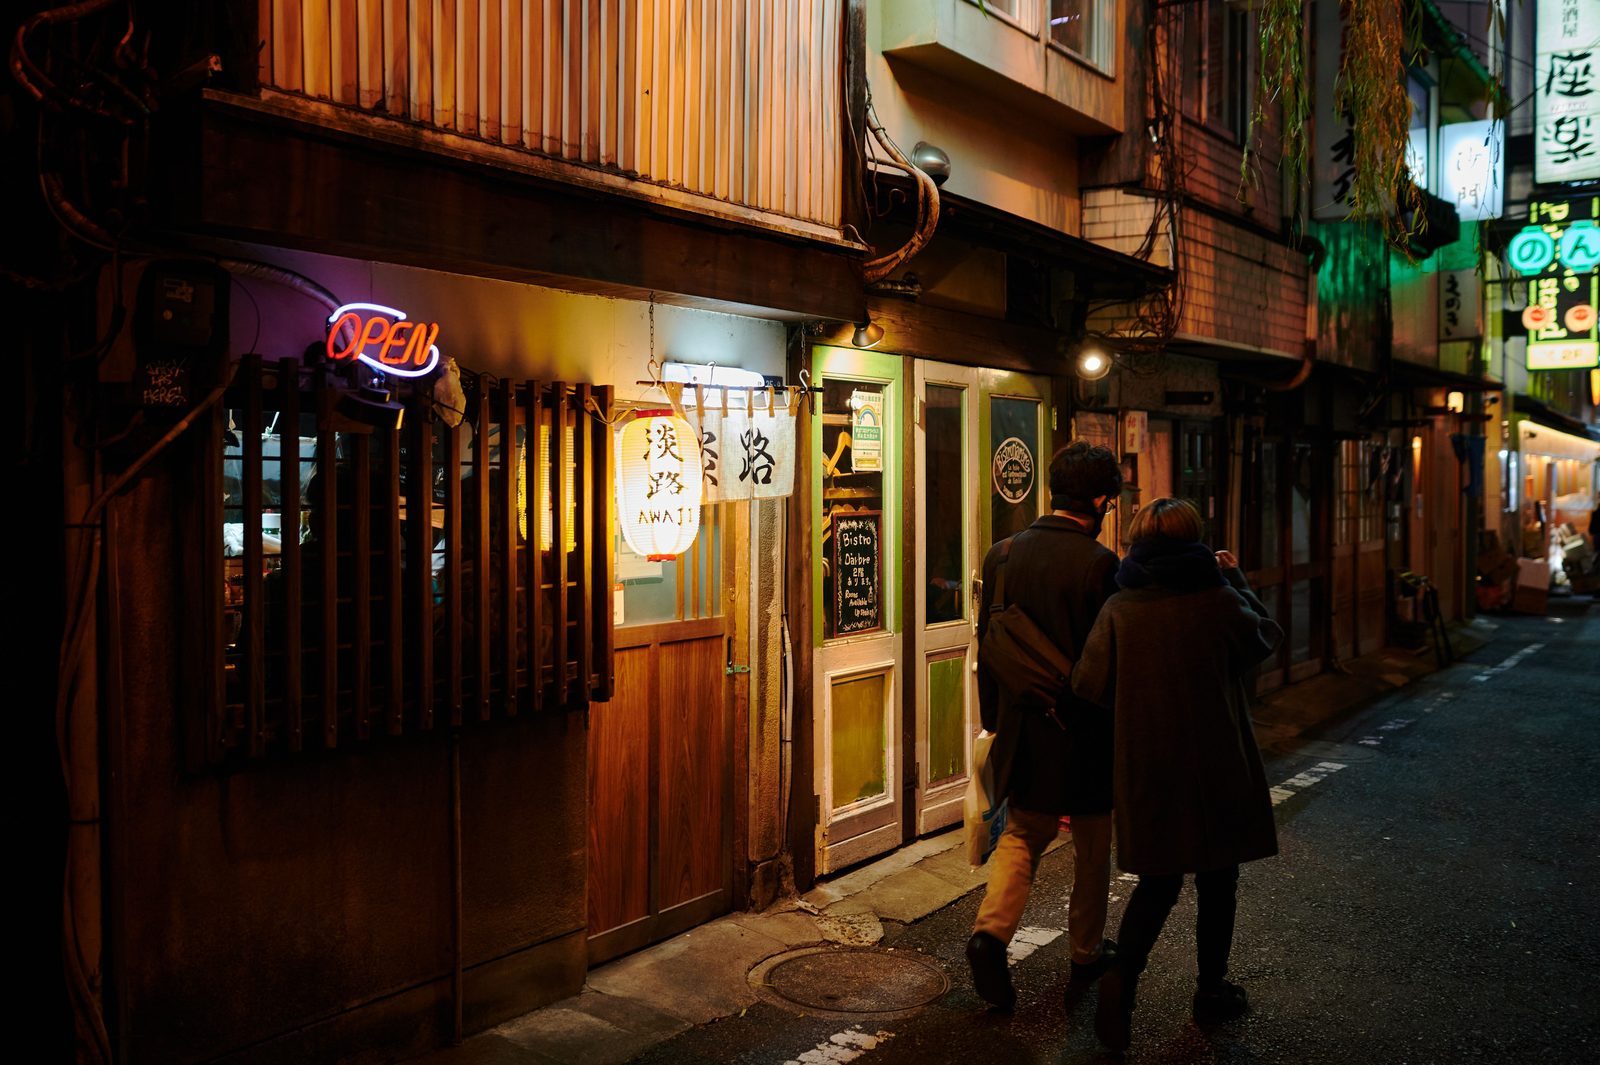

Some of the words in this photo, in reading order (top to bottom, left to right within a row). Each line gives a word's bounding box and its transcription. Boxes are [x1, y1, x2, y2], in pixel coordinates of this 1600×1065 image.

[1561, 0, 1578, 37] 酒屋
[327, 312, 440, 366] OPEN
[643, 424, 686, 500] 淡路
[638, 507, 693, 526] AWAJI
[842, 532, 871, 547] Bistro
